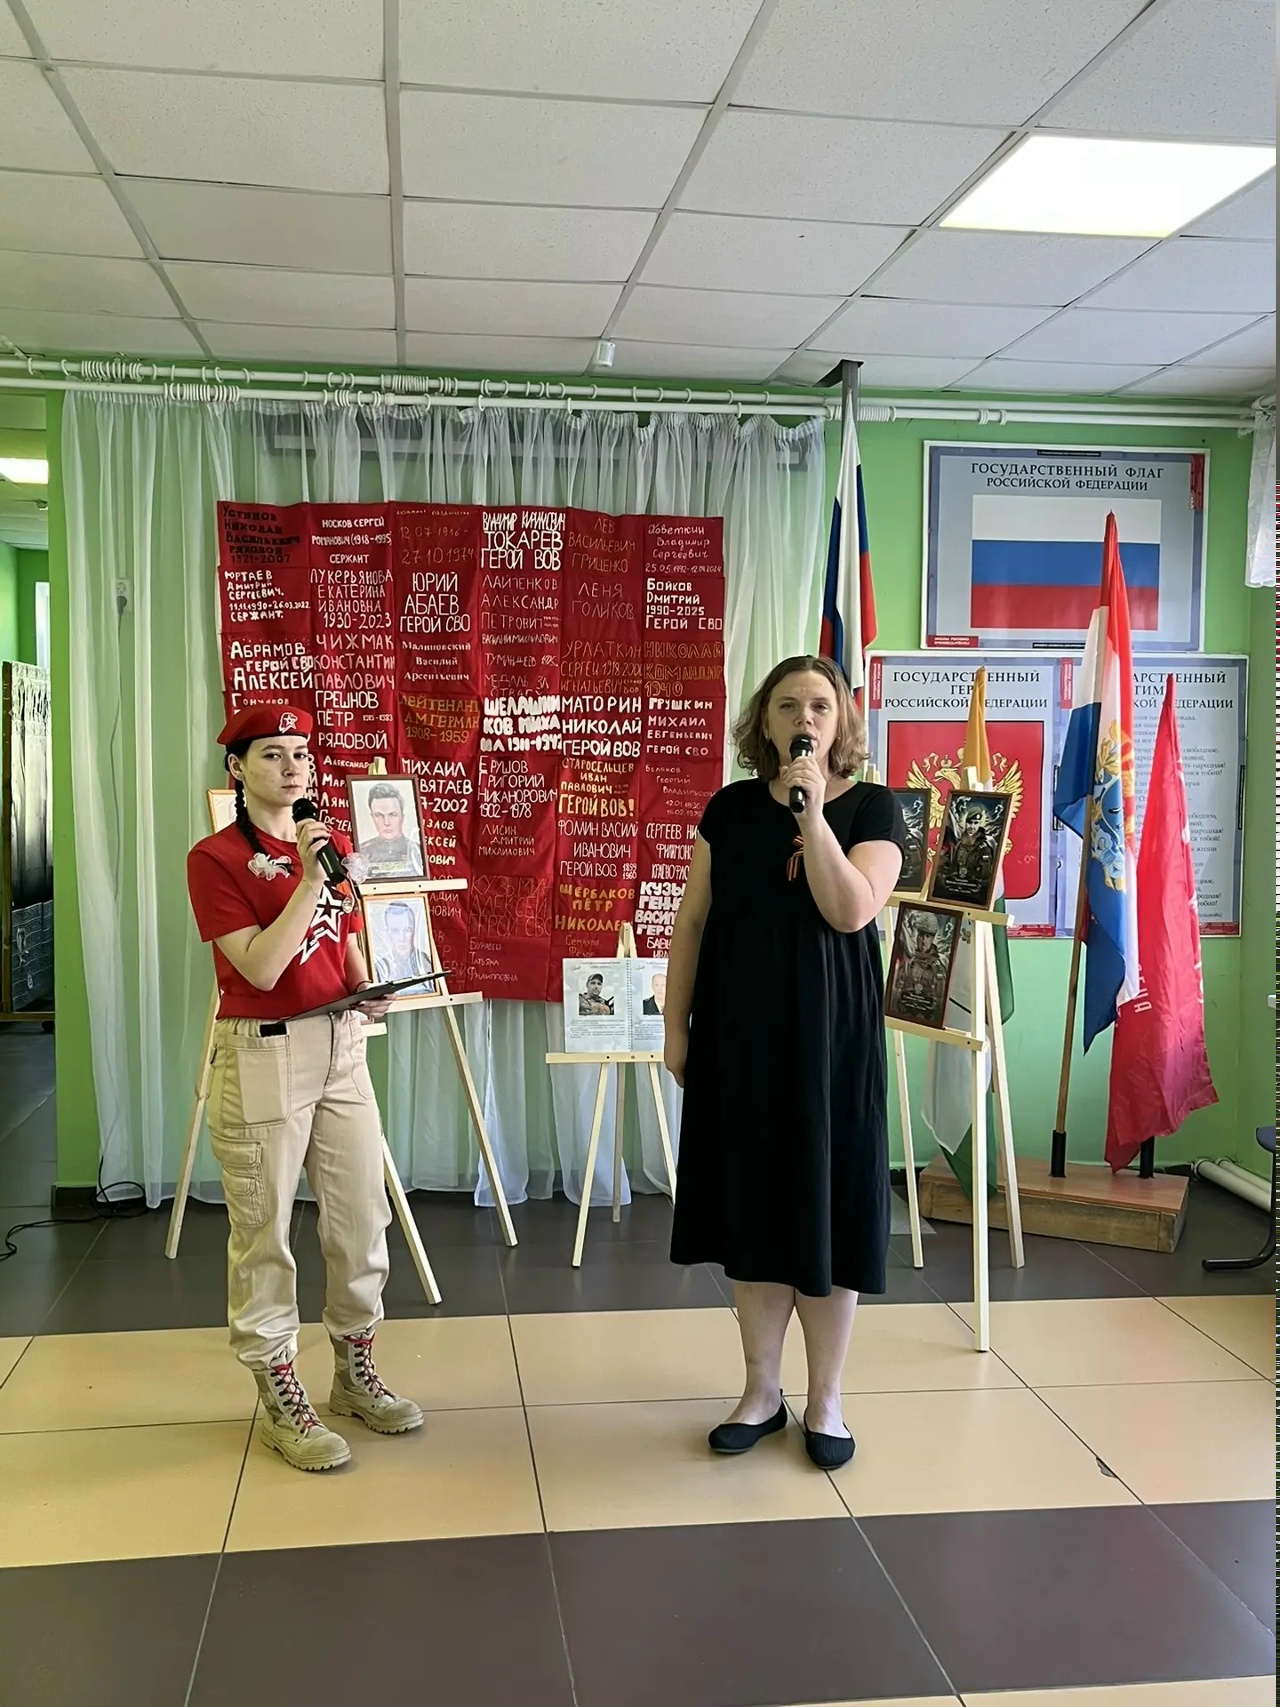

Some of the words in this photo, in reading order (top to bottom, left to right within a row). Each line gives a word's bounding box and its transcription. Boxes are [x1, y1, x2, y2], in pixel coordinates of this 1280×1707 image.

[971, 462, 1118, 478] ГОСУДАРСТВЕННЫЙ
[1125, 467, 1165, 479] ФЛАГ
[987, 475, 1070, 490] РОССИЙСКОЙ
[1075, 479, 1148, 492] ФЕДЕРАЦИИ
[593, 516, 616, 534] ЛЕВ
[483, 529, 564, 551] ТОКАРЕВ
[329, 553, 370, 564] СЕРЖАНТ
[481, 548, 523, 570] ГЕРОЙ
[534, 549, 562, 571] ВОВ
[412, 571, 459, 592] ЮРИЙ
[577, 582, 623, 599] ЛЕНЯ
[317, 583, 386, 599] ЕКАТЕРИНА
[318, 599, 382, 614] ИВАНОВНА
[404, 593, 460, 616] АБАЕВ
[480, 592, 560, 611] АЛЕКСАНДР
[646, 605, 706, 617] 1990-2025
[323, 611, 392, 630] 1930-2023
[399, 615, 442, 634] ГЕРОЙ
[445, 613, 471, 633] СВО
[645, 615, 689, 630] ГЕРОЙ
[698, 617, 723, 631] СВО
[316, 632, 394, 651] ЧИЖМАК
[643, 640, 724, 659] НИКОЛАЙ
[415, 656, 459, 666] Василий
[313, 671, 395, 690] ПАВЛОВИЧ
[893, 669, 1040, 684] ГОСУДАРСТЕННЫЙ
[951, 684, 974, 695] ГЕР
[315, 690, 380, 709] ГРЕШНОВ
[561, 695, 642, 714] МАТОРИН
[884, 697, 969, 708] РОССИЙСКОЙ
[985, 698, 1048, 709] ЕДЕРАЦИИ
[562, 717, 642, 736] НИКОЛАЙ
[647, 715, 707, 728] МИХАИЛ
[318, 729, 388, 750] РЯДОВОЙ
[563, 739, 612, 757] ГЕРОЙ
[612, 740, 641, 758] ВОВ
[646, 744, 680, 755] ГЕРОЙ
[685, 746, 709, 757] СВО
[401, 757, 467, 777] МИХАИЛ
[580, 771, 608, 784] ИВАН
[560, 780, 613, 795] ПАВЛОВИЧ
[558, 793, 598, 816] ГЕРОЙ
[645, 822, 682, 840] СЕРГЕЕВ
[573, 842, 632, 859] ИВАНОВИЧ
[559, 860, 593, 877] ГЕРОЙ
[594, 862, 618, 877] ВОВ
